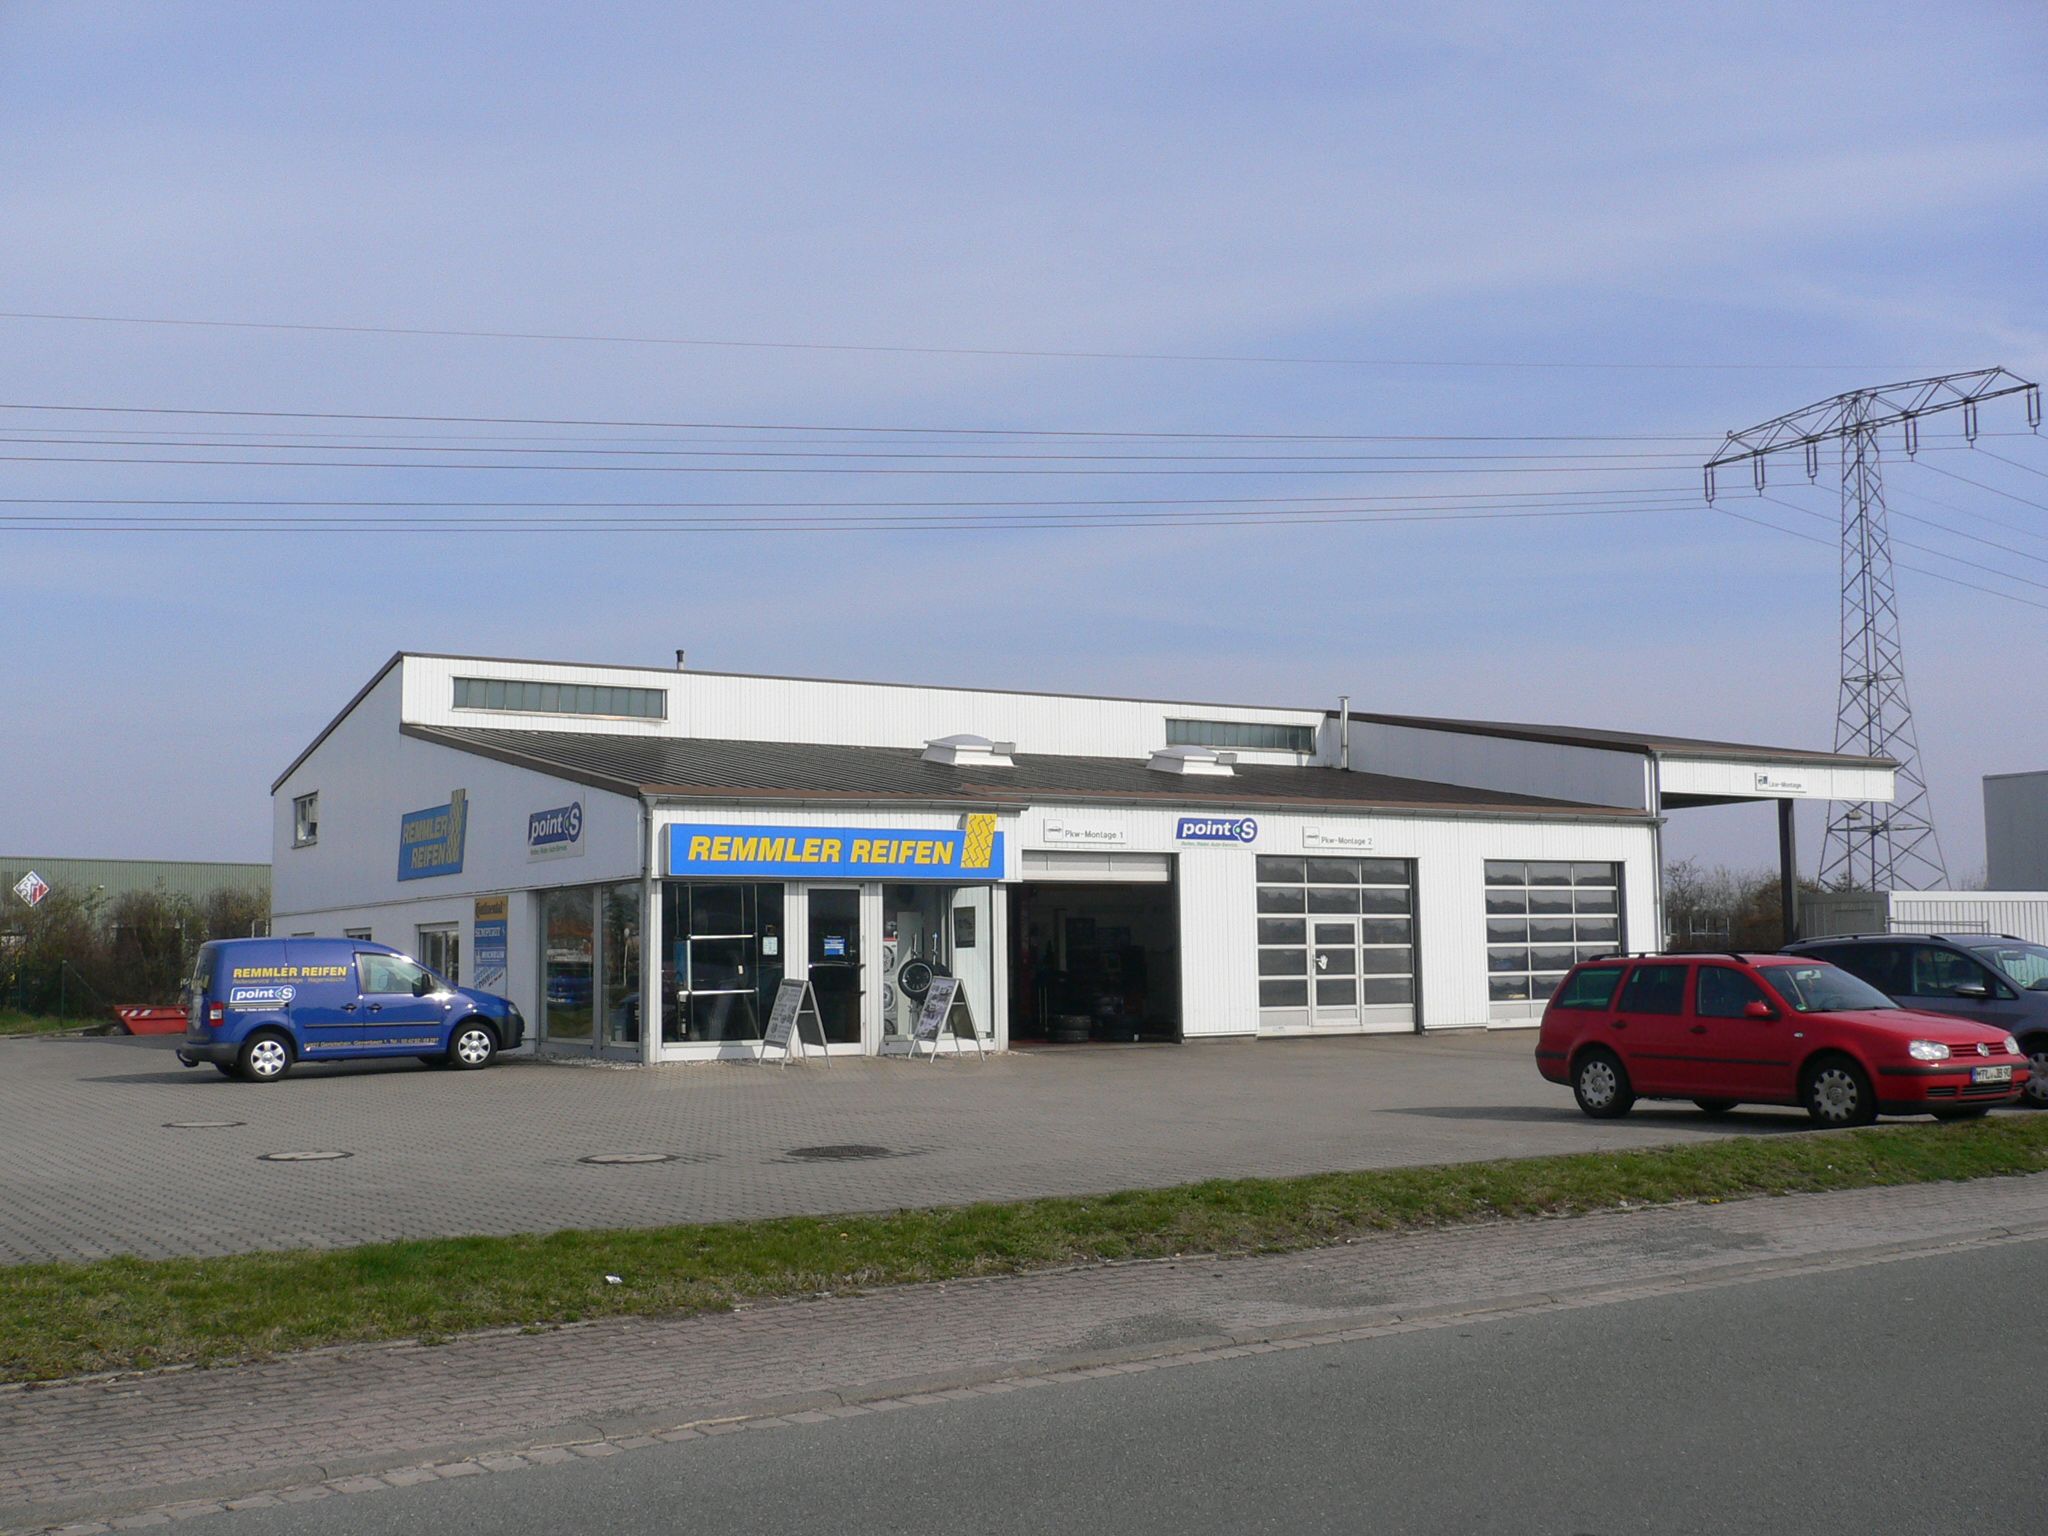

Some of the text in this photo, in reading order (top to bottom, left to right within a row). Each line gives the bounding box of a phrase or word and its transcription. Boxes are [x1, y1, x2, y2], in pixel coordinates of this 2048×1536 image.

[403, 815, 449, 844] REMMLER
[531, 808, 580, 843] point S
[1065, 829, 1124, 840] Pkw-Montage 1
[1182, 820, 1256, 839] point S
[688, 835, 954, 865] REMMLER REIFEN
[1321, 836, 1373, 846] Pkw-Montage 2
[411, 844, 448, 869] REIFEN
[233, 966, 347, 978] REMMLER REIFEN
[236, 987, 293, 1001] point S
